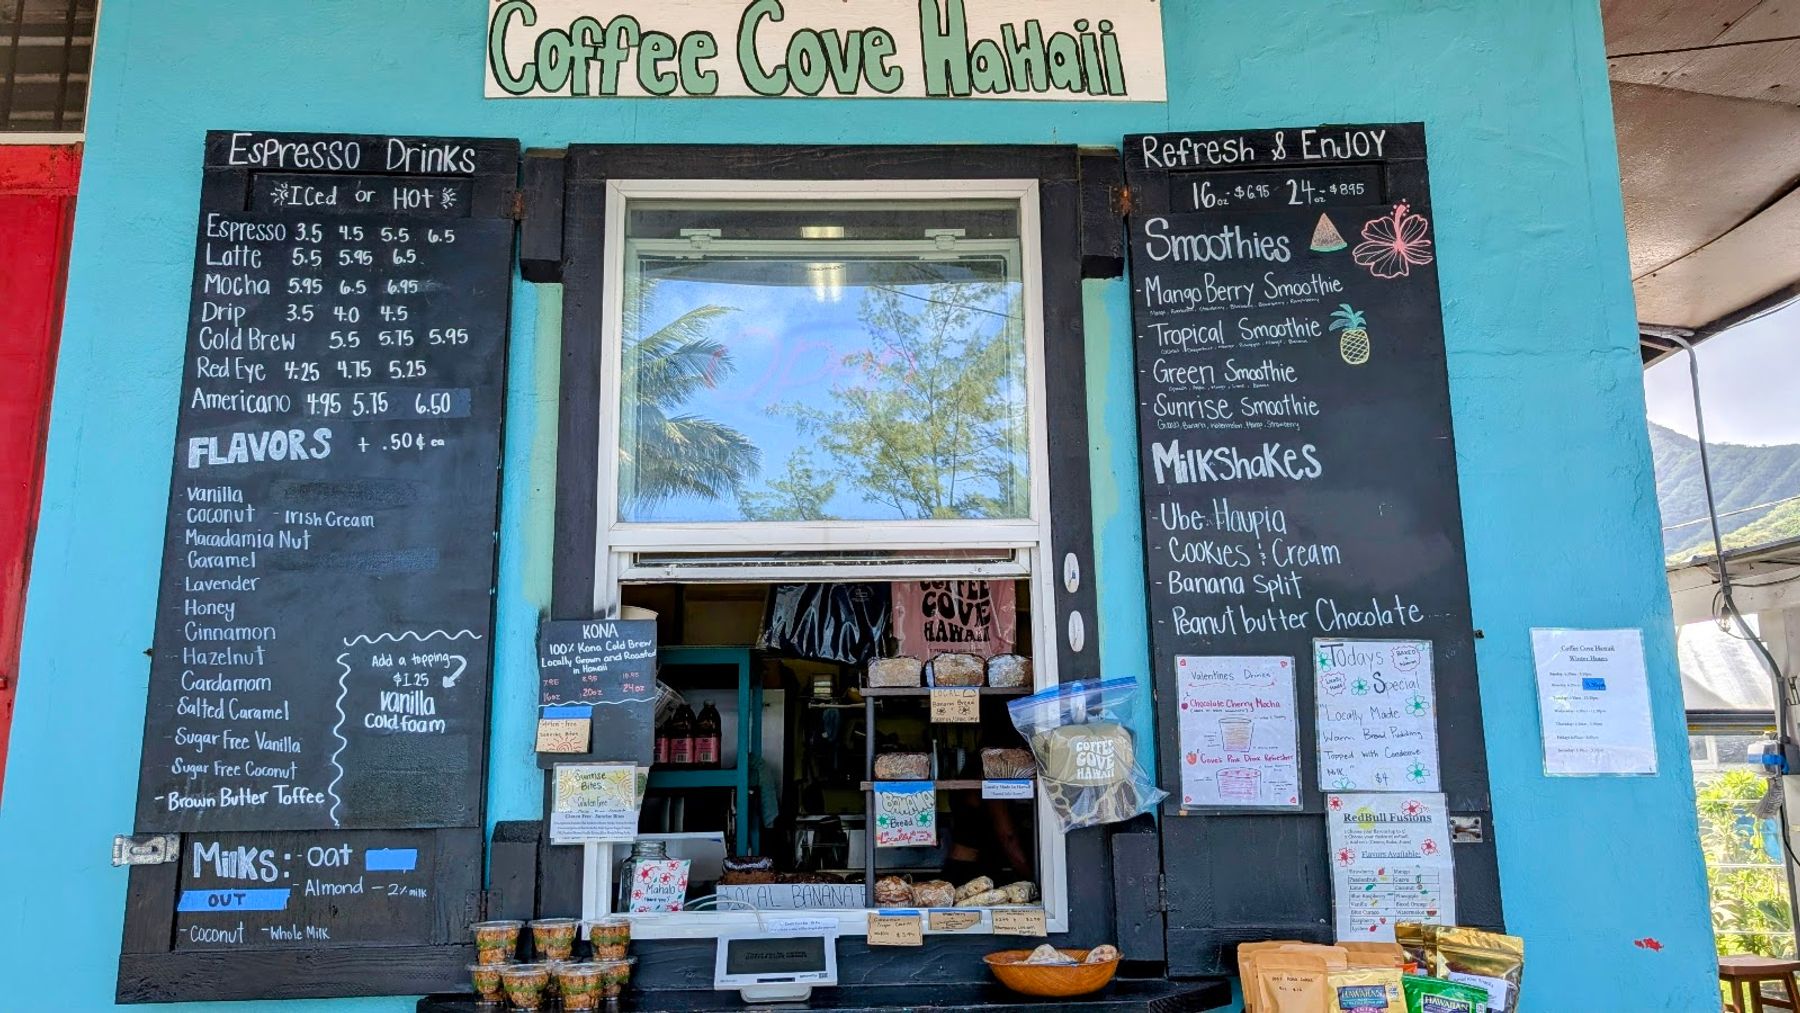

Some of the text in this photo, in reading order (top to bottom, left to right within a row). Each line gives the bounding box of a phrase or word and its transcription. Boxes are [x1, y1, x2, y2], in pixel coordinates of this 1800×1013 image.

[488, 0, 718, 96] Coffee
[737, 0, 904, 96] Cove
[228, 133, 476, 173] Espresso Drinks
[1142, 136, 1255, 168] Refresh
[1272, 132, 1286, 161] &
[288, 185, 434, 208] Iced or Hot
[207, 213, 455, 243] Espresso 3.5 4.5 5.5 6.5
[1145, 217, 1291, 262] Smoothies
[206, 244, 416, 267] Latte 5.5 5.95 6.5
[205, 274, 418, 295] Mocha 5.95 6.5 6.95
[1146, 275, 1202, 310] Mango
[1205, 273, 1254, 308] Berry
[1265, 271, 1343, 300] Smoothie
[202, 302, 408, 326] Drip 3.5 4.0 4.5
[200, 327, 468, 351] Cold Brew 5.5 5.75 5.95
[1148, 321, 1224, 352] Tropical
[1242, 318, 1321, 341] Smoothie
[197, 358, 426, 383] Red Eye 4.25 4.75 5.25
[1153, 359, 1297, 384] Green Smoothie
[192, 388, 451, 415] Americano 4.95 5.75 6.50
[1154, 393, 1320, 420] Sunrise Smoothie
[188, 428, 332, 468] FLAVORS
[1152, 440, 1322, 484] Milkshakes
[187, 486, 243, 503] Vanilla
[187, 508, 255, 523] Coconut
[285, 510, 374, 528] Irish Cream
[1161, 498, 1286, 539] Ube Haupia
[186, 530, 311, 549] Macadamia Nut
[188, 552, 256, 569] Caramel
[1169, 537, 1341, 567] Cookies Cream
[186, 576, 260, 591] Lavender
[1169, 570, 1302, 602] Banana Split
[185, 600, 235, 621] Honey
[922, 592, 990, 627] COVE
[1172, 595, 1424, 636] Peanut butter Chocolate
[185, 623, 276, 641] Cinnamon
[583, 623, 619, 639] KONA
[183, 646, 265, 666] Hazelnut
[542, 658, 571, 667] Locally
[604, 652, 622, 662] and
[624, 649, 656, 660] Roasted
[550, 640, 651, 655] 100% Kona Cold Brew
[372, 652, 450, 669] Add a topping
[583, 663, 607, 673] Hawaii
[1320, 644, 1383, 673] Todays
[181, 671, 271, 692] Cardamom
[393, 672, 429, 688] $1.25
[1191, 671, 1234, 681] Valentines
[1373, 672, 1420, 694] Special
[177, 697, 289, 721] Salted Caramel
[1190, 698, 1224, 708] Chocolate
[1226, 699, 1254, 712] Cherry
[1256, 698, 1280, 709] Mocha
[1370, 707, 1400, 719] Made
[365, 713, 445, 733] Cold foam
[175, 727, 301, 753] Sugar Free Vanilla
[1076, 740, 1113, 751] COFFEE
[1076, 752, 1114, 769] COVE
[1227, 755, 1240, 763] Pink
[1324, 751, 1354, 761] Topped
[172, 758, 297, 779] Sugar Free Coconut
[1077, 769, 1114, 779] HAWAII
[1375, 772, 1388, 785] $4
[581, 782, 602, 791] Bites
[168, 785, 325, 810] Brown Butter Toffee
[890, 818, 913, 828] Bread
[1344, 813, 1432, 822] RedBull Fusions
[308, 843, 353, 867] Oat
[305, 877, 363, 897] Almond
[388, 884, 427, 897] 2% milk
[646, 884, 675, 894] Mahalo
[792, 885, 854, 908] BANANA
[208, 893, 245, 907] OUT
[190, 922, 245, 943] Coconut
[270, 926, 330, 941] Whole Milk
